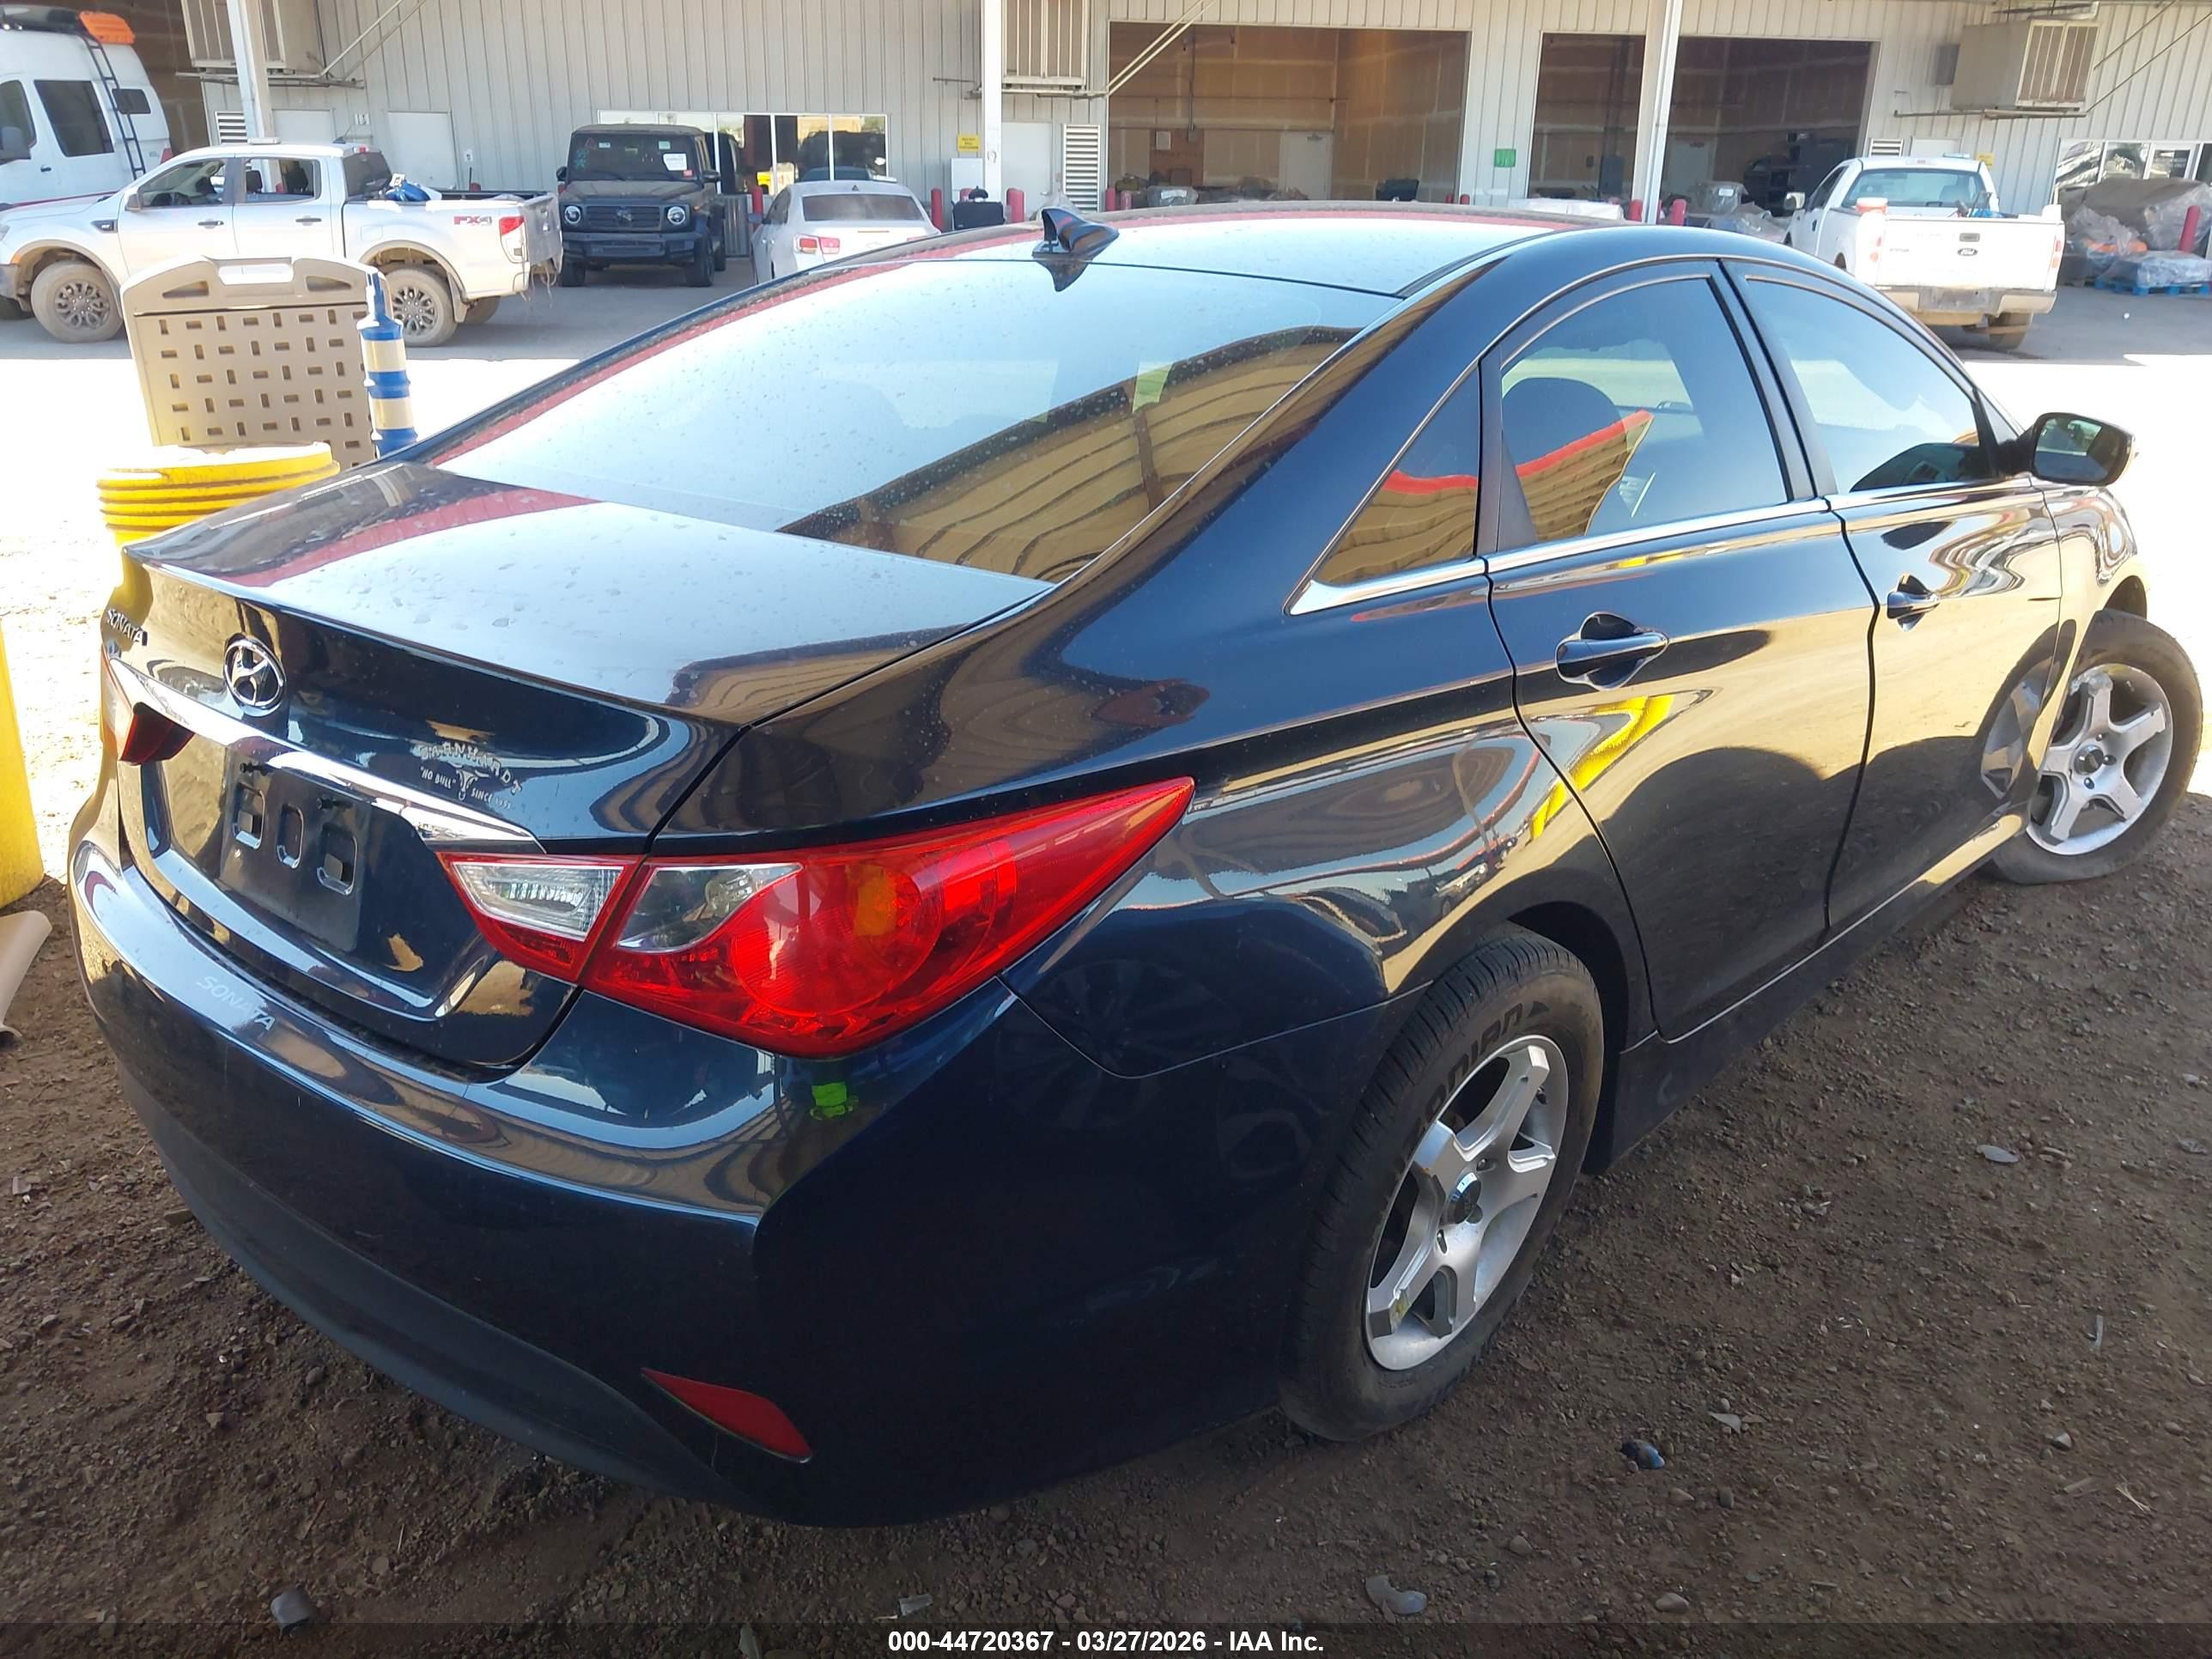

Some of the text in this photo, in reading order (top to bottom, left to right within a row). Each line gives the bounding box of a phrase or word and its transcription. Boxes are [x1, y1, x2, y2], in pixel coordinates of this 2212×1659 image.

[453, 216, 493, 225] FX4
[107, 609, 148, 647] SONATA
[196, 976, 275, 1030] SONATA
